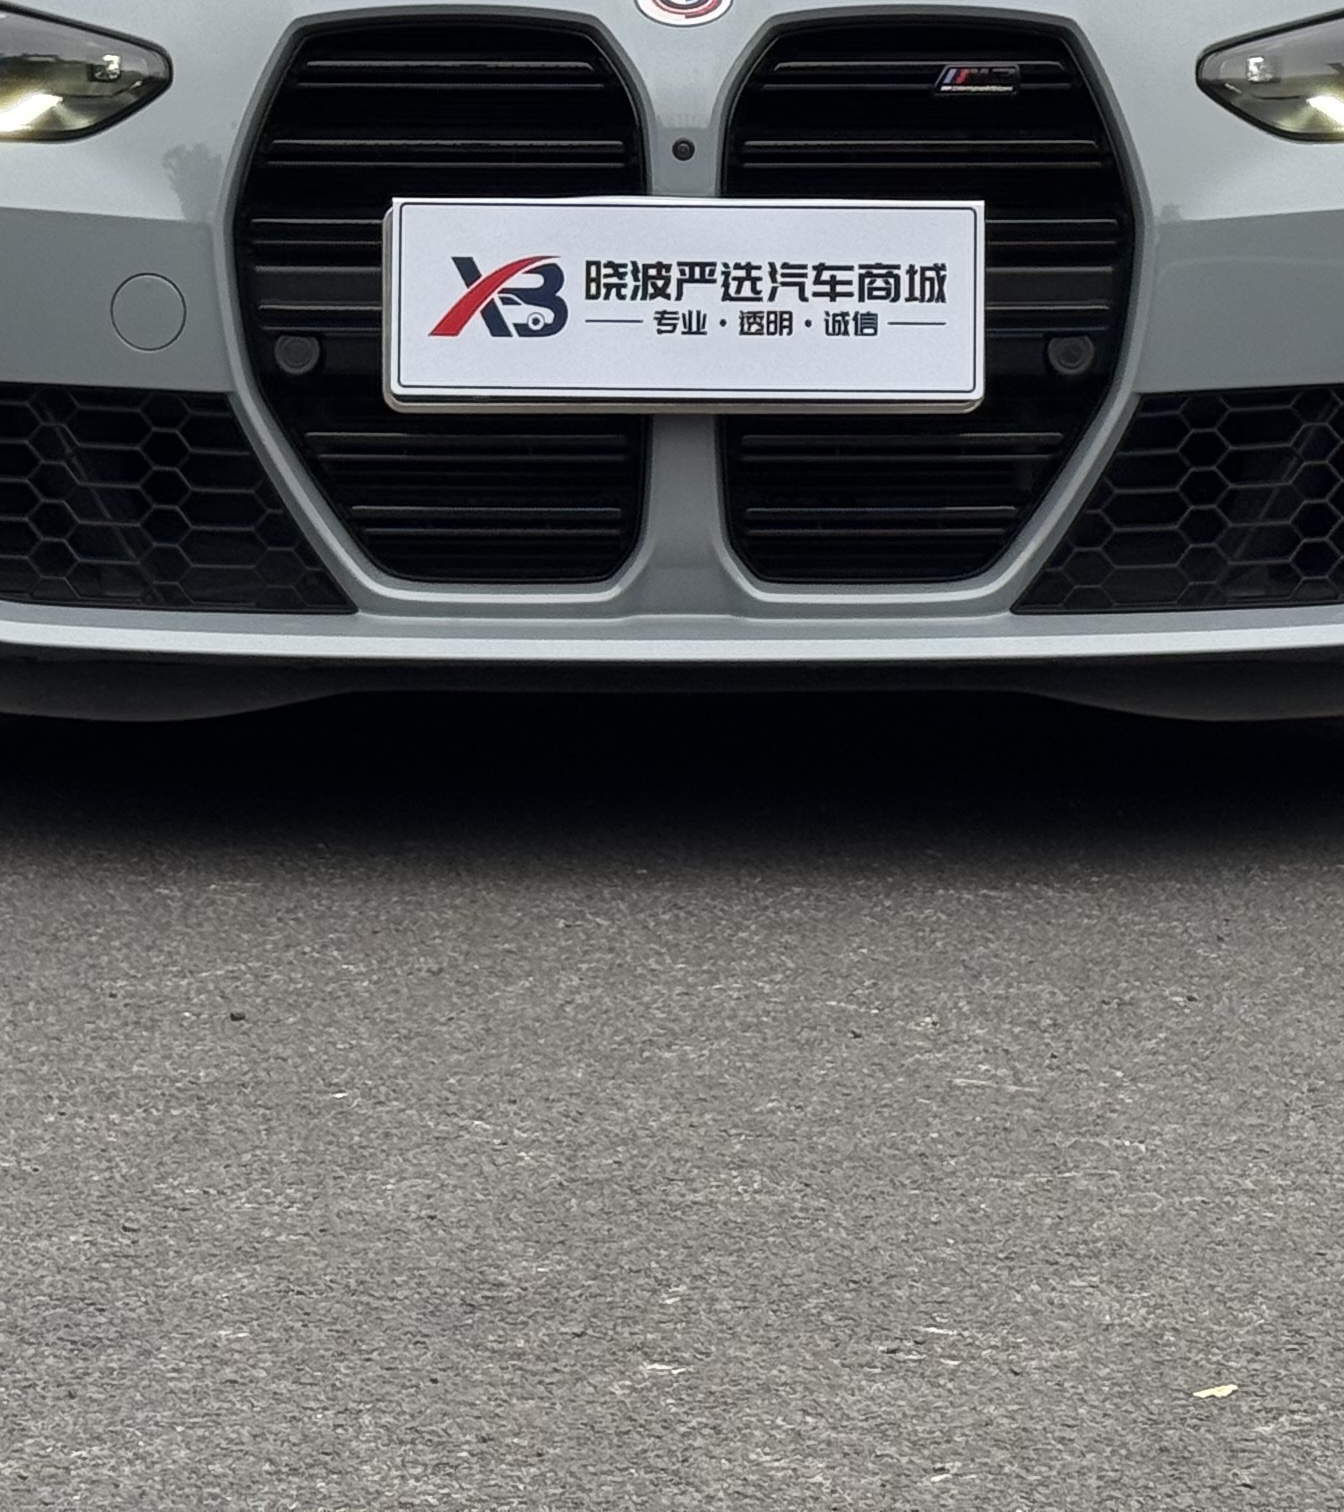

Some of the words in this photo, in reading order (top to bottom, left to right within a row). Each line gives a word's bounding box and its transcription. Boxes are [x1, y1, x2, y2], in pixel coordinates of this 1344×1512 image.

[584, 259, 947, 304] 晓波严选汽车商城
